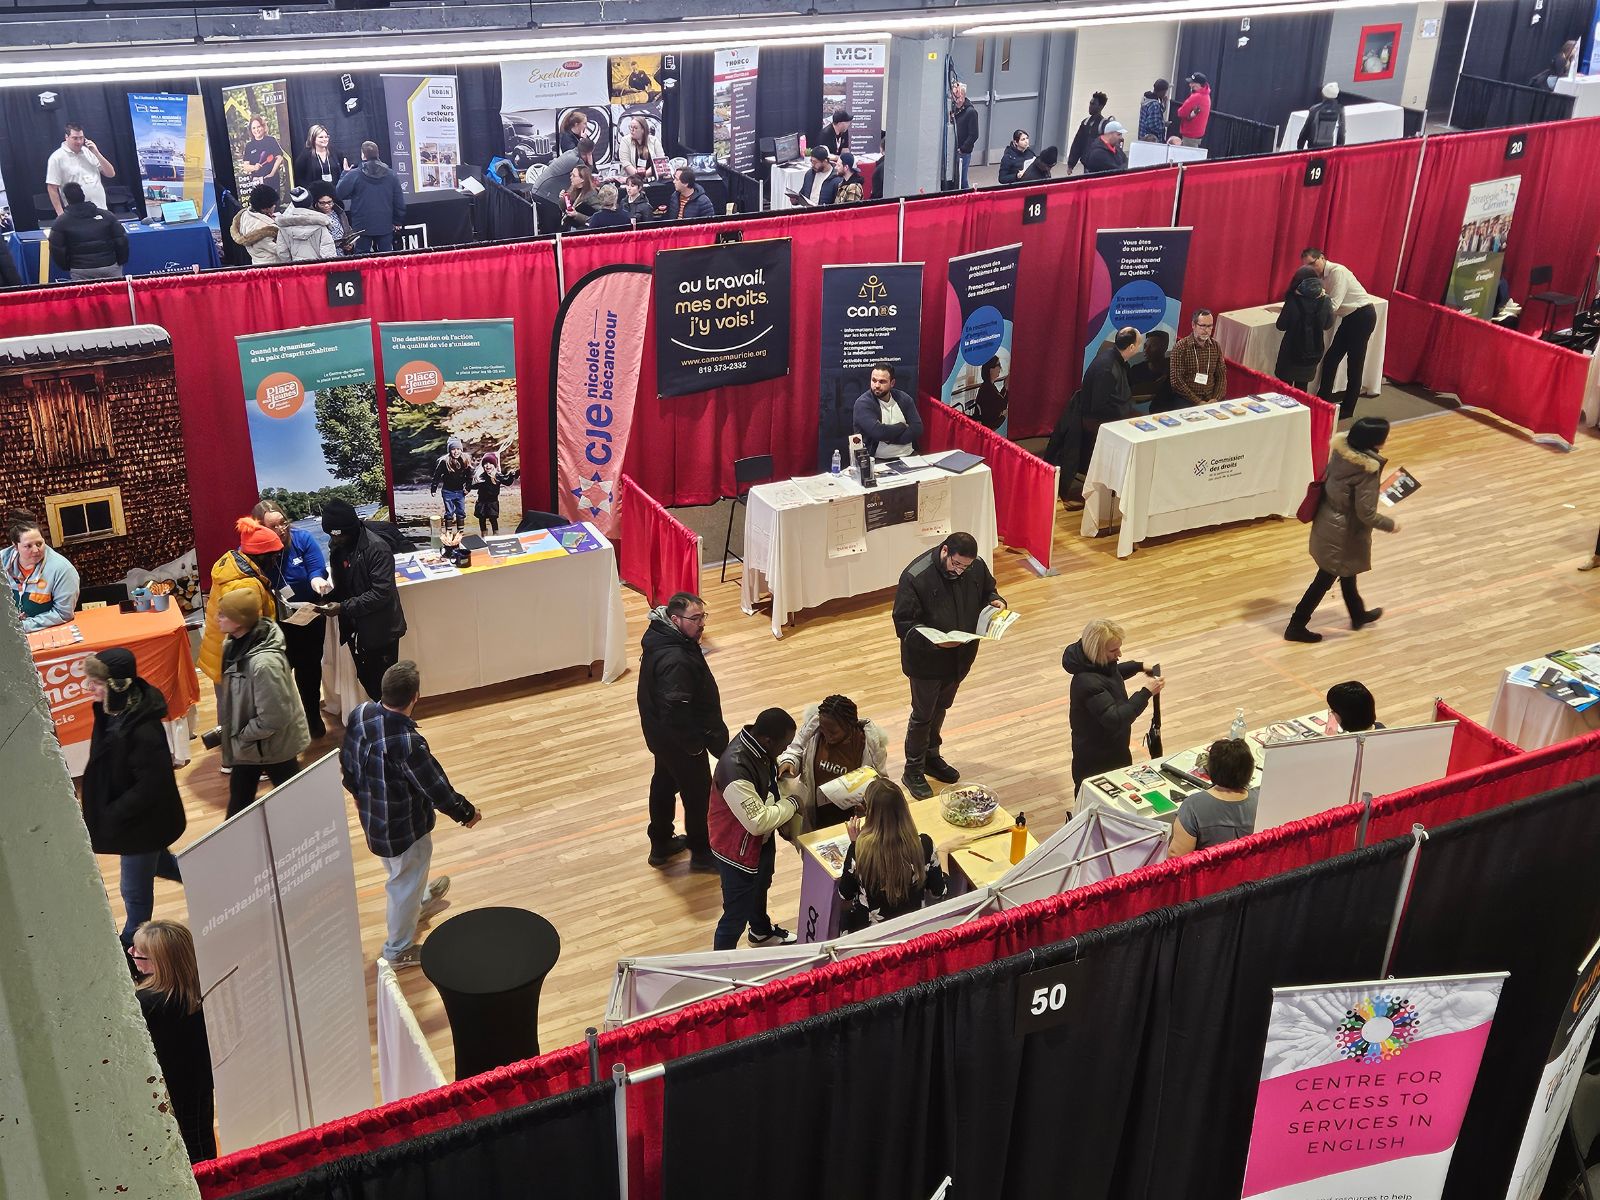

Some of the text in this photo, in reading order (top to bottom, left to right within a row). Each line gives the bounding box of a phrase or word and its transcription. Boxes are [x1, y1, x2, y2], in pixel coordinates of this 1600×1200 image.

[528, 68, 580, 83] Excellence
[1511, 142, 1522, 154] 20
[1310, 168, 1321, 180] 19
[1029, 204, 1041, 217] 18
[968, 262, 991, 272] Avez-vous
[968, 269, 993, 279] problèmes
[679, 268, 765, 294] au travail,
[967, 281, 995, 291] Prenez-vous
[335, 282, 355, 297] 16
[977, 286, 1007, 296] médicaments
[675, 289, 769, 314] mes droits,
[689, 316, 710, 337] j'y
[970, 333, 1001, 345] discrimination
[250, 348, 271, 356] Quand
[279, 342, 316, 352] dynamisme
[265, 354, 280, 362] paix
[280, 350, 305, 360] d'esprit
[305, 346, 338, 356] cohabitent
[406, 343, 429, 351] qualité
[599, 310, 618, 400] bécancour
[681, 349, 767, 366] www.canosmauricie.org
[584, 341, 600, 399] nicolet
[698, 362, 747, 374] 819 373-2332
[404, 372, 435, 386] Place
[266, 382, 296, 399] Place
[406, 378, 436, 396] Jeunes
[268, 390, 297, 409] Jeunes
[1210, 454, 1245, 466] Commission
[1220, 462, 1238, 470] droits
[55, 714, 75, 726] cie
[819, 760, 847, 775] HUGO
[1030, 983, 1067, 1016] 50
[1294, 1070, 1443, 1091] CENTRE FOR
[1299, 1092, 1429, 1113] ACCESS TO
[1287, 1114, 1433, 1135] SERVICES IN
[1307, 1136, 1406, 1154] ENGLISH
